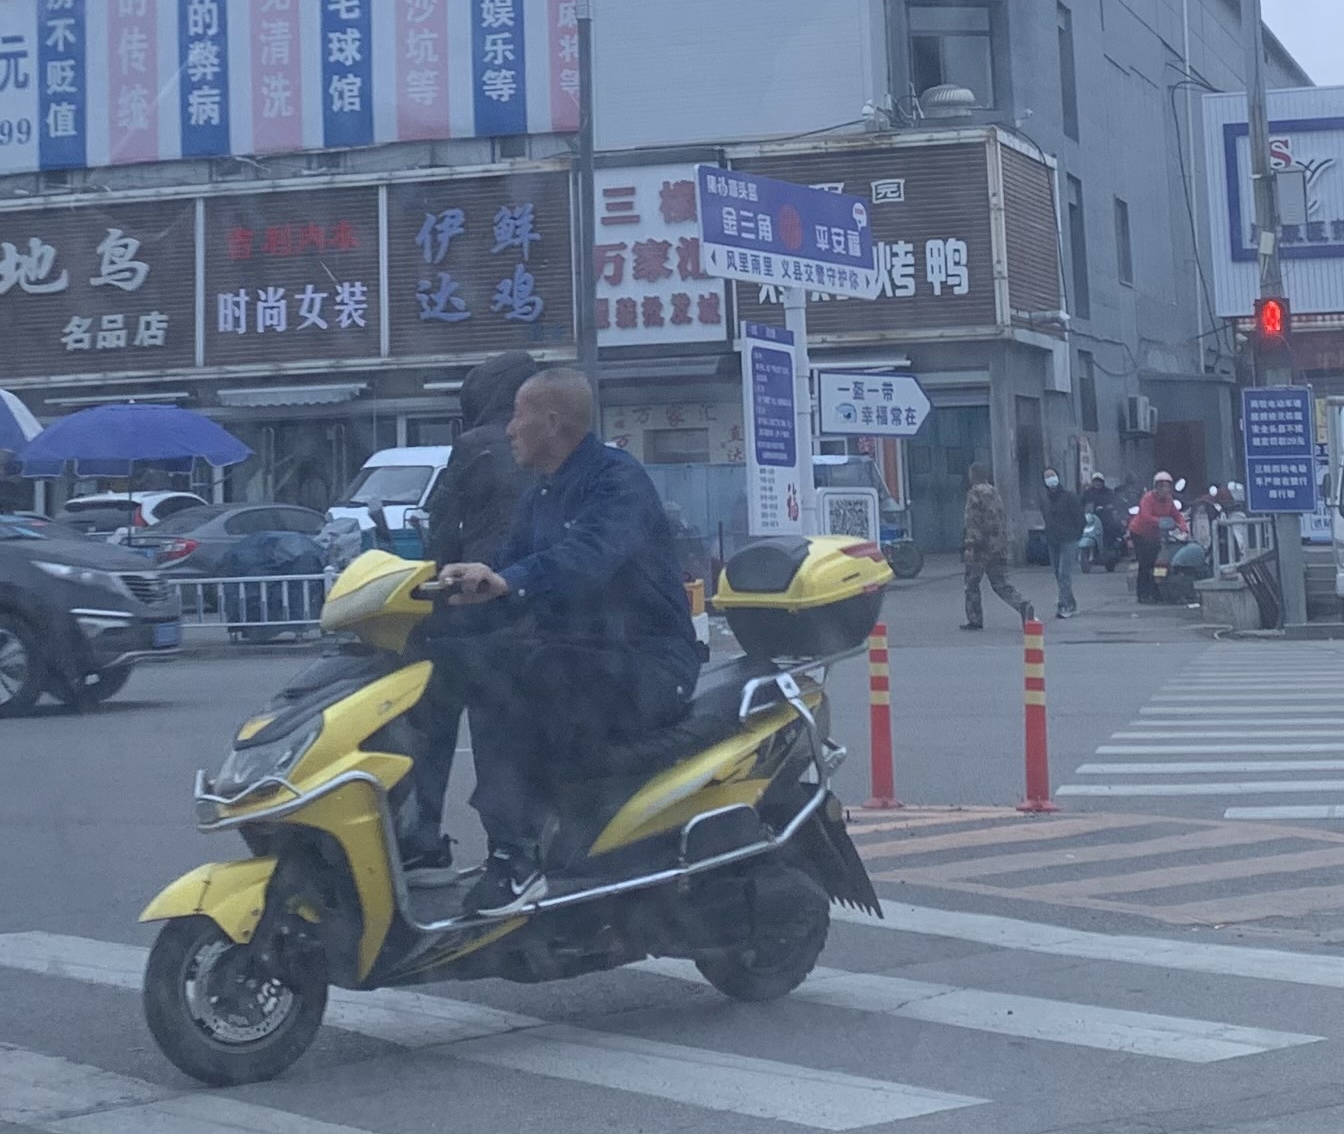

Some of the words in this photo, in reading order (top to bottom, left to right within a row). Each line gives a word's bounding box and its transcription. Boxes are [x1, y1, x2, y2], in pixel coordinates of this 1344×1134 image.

[721, 206, 774, 244] 金三角
[813, 223, 862, 258] 平安福
[725, 249, 775, 278] 风里雨里
[780, 259, 860, 292] 义县交警守护你
[61, 310, 170, 352] 名品店
[216, 280, 370, 335] 时尚女装
